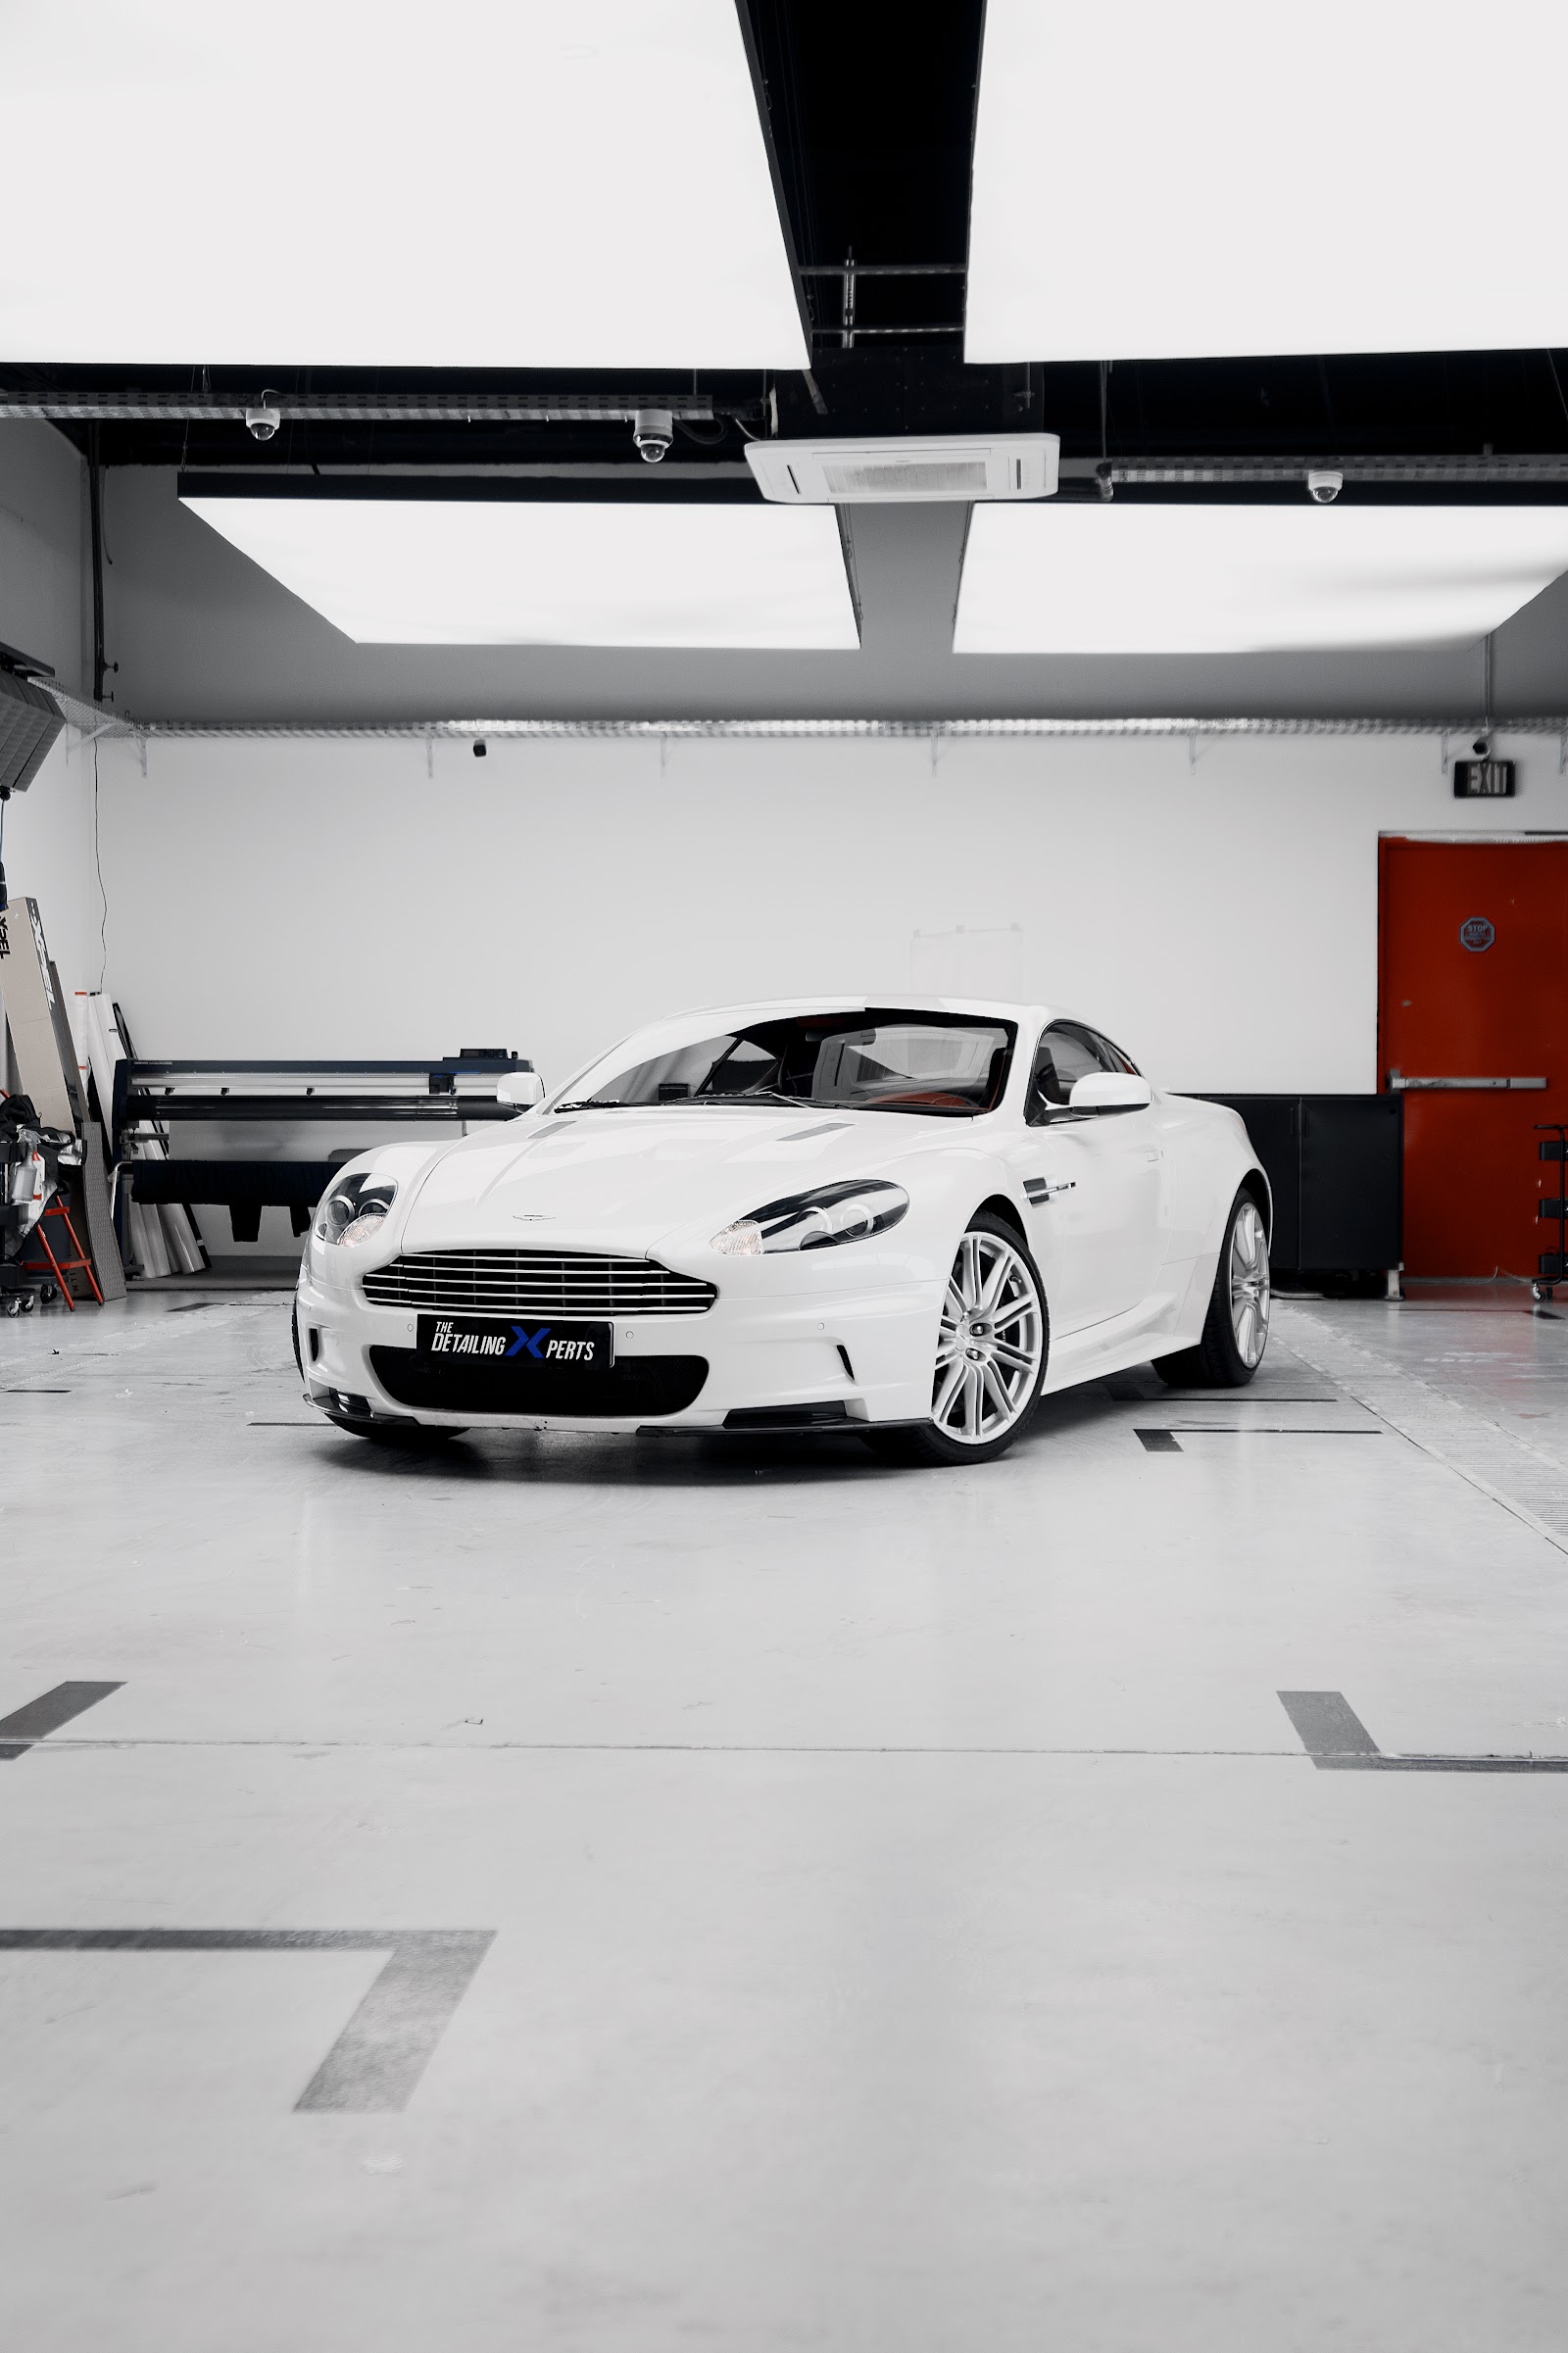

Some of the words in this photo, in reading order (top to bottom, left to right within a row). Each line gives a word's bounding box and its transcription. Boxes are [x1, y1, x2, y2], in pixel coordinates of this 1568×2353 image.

[1467, 762, 1508, 795] EXIT
[435, 1321, 454, 1334] THE
[431, 1333, 506, 1355] DETAILING
